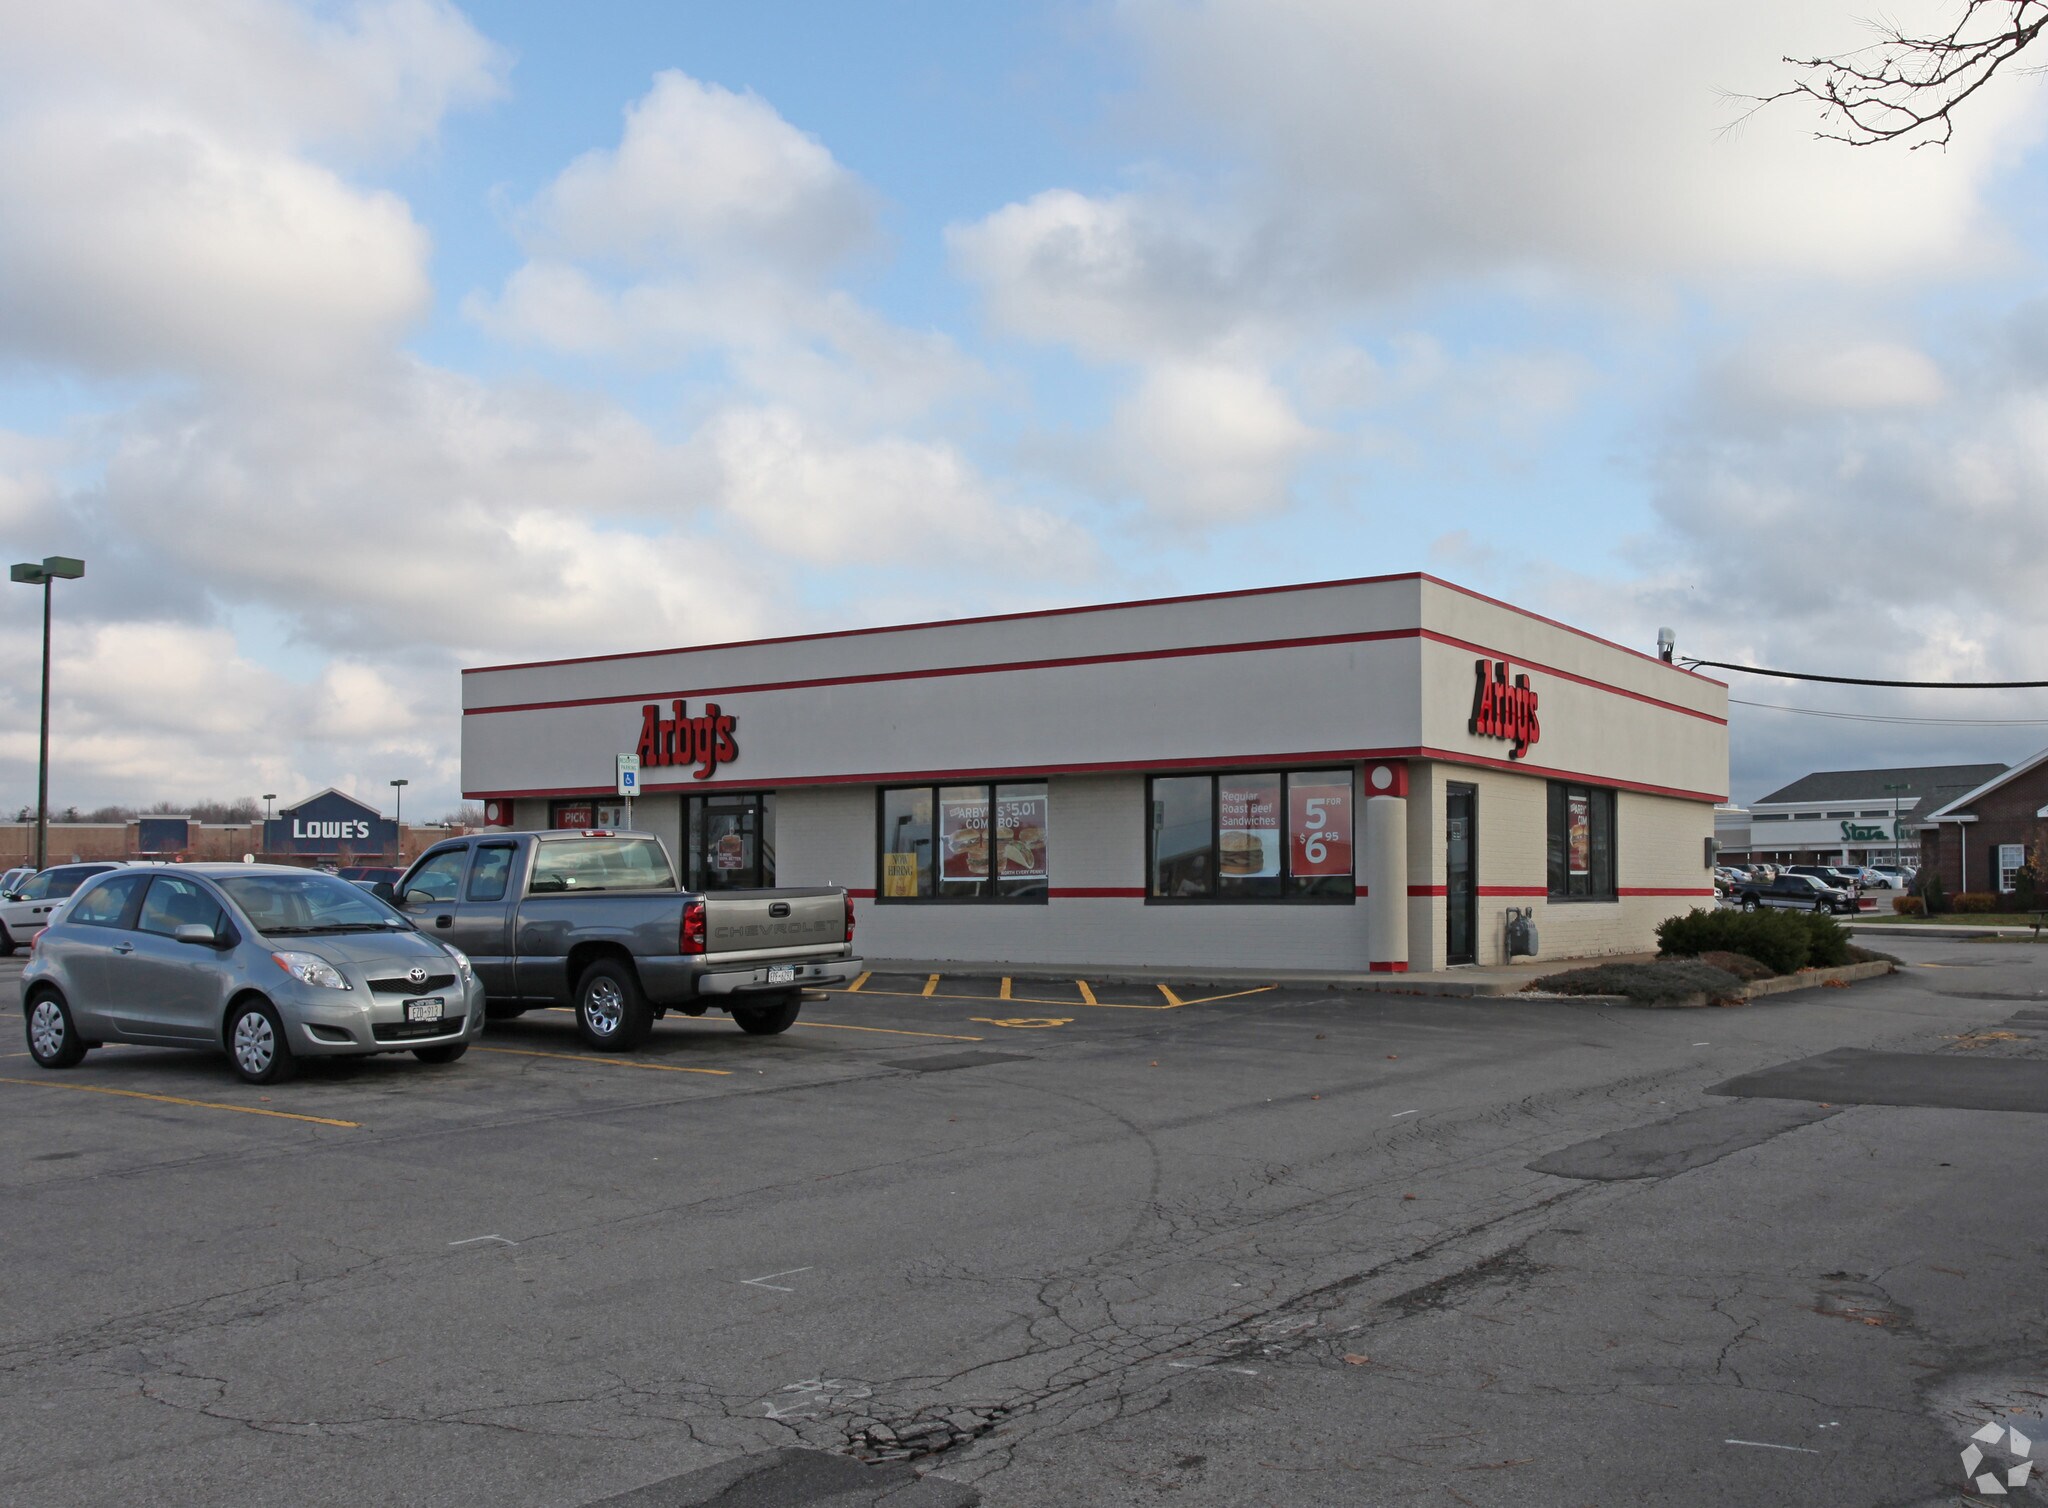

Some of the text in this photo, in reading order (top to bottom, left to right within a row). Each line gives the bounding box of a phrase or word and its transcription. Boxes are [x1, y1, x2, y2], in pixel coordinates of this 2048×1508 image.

[1468, 659, 1540, 759] Arby's
[636, 699, 739, 779] Arby's
[1221, 791, 1258, 801] Regular
[1221, 803, 1272, 813] Roast Beef
[565, 812, 586, 823] PICK
[1222, 816, 1275, 826] Sandwiches
[293, 819, 369, 838] LOWE'S
[887, 865, 913, 876] HIRING
[714, 919, 839, 939] CHEVROLET
